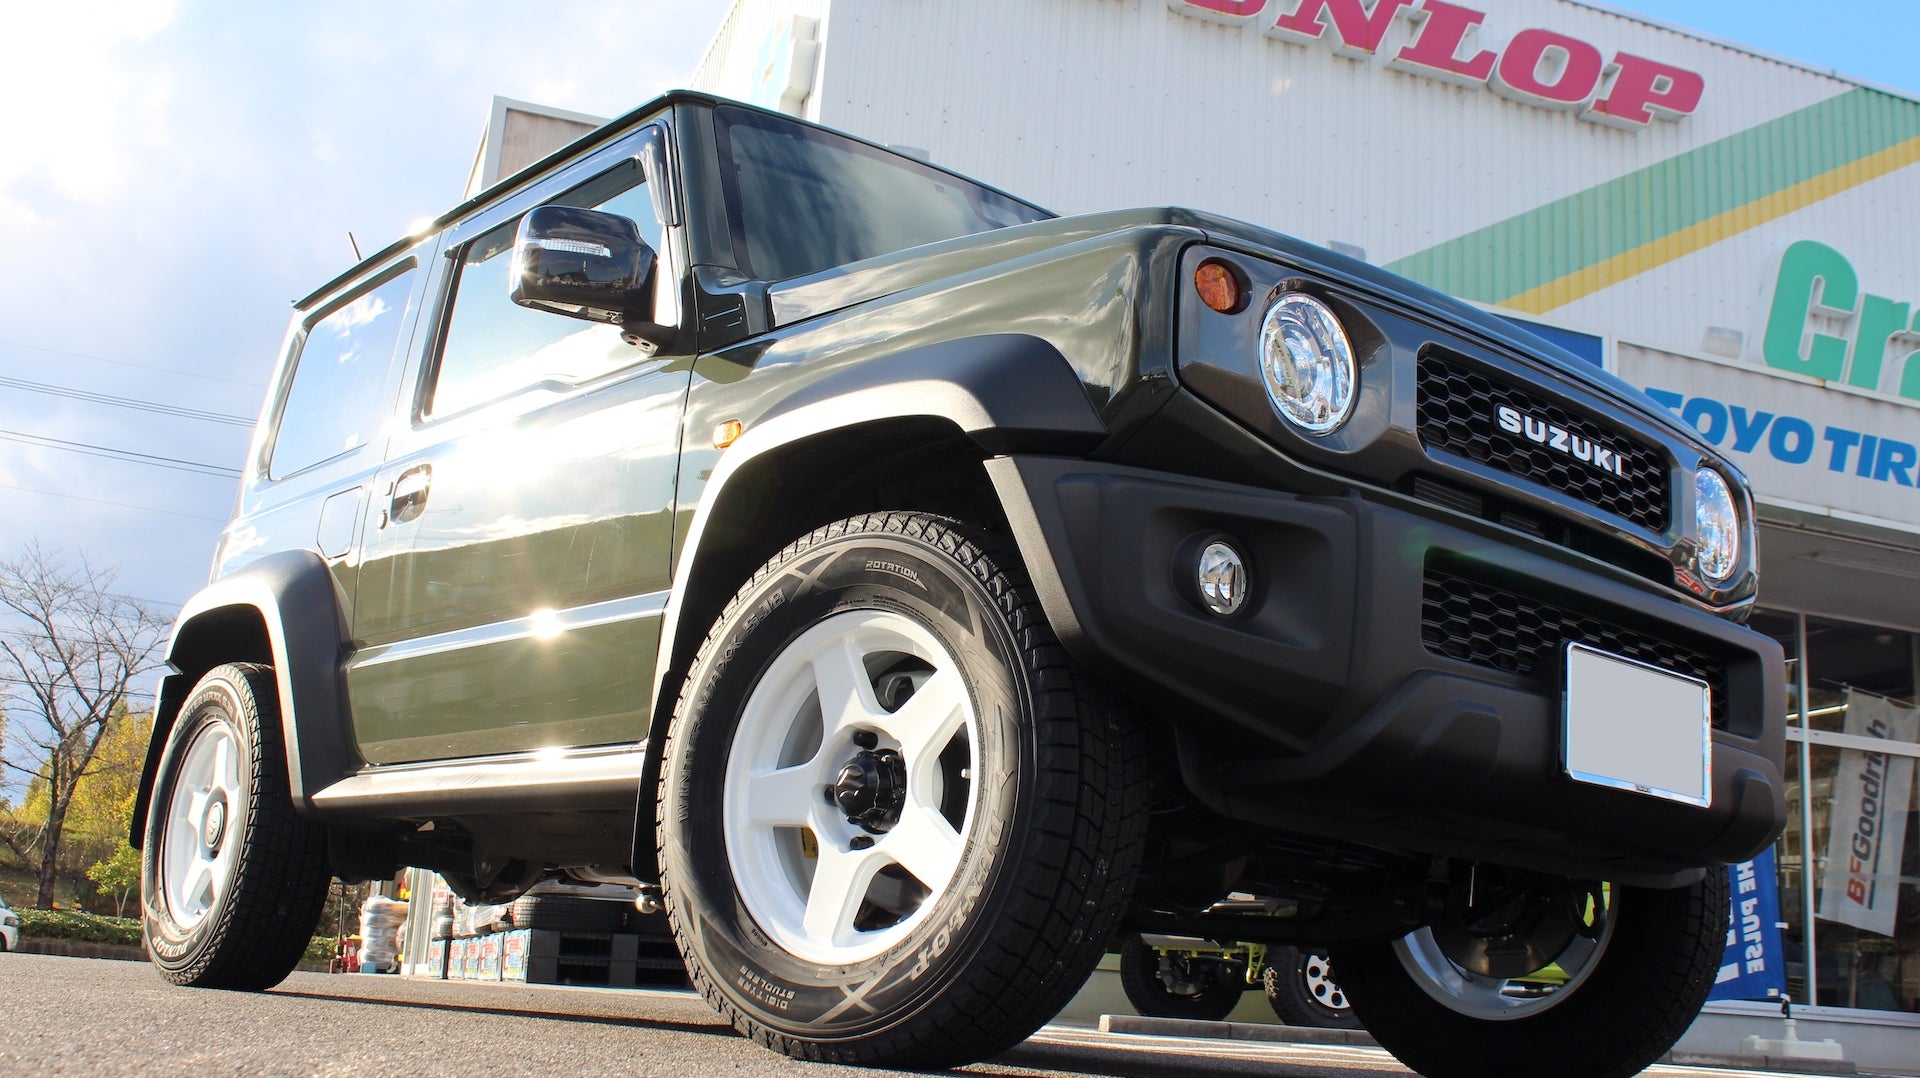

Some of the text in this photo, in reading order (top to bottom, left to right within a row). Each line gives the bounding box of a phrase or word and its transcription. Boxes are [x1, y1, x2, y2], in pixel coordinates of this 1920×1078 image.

[1183, 0, 1704, 124] NLOP
[1762, 239, 1920, 401] Cr
[1498, 406, 1622, 476] SUZUKI
[1824, 426, 1920, 490] TIR
[865, 560, 917, 581] ROTATION
[678, 715, 704, 823] WINTER
[697, 634, 744, 711] MAXX
[1846, 718, 1886, 906] BFGoodrih
[911, 809, 1005, 981] DUNLOP
[152, 935, 190, 957] DUNLOP
[737, 976, 789, 1010] DIGI TYRE
[740, 964, 796, 999] STUDLESS
